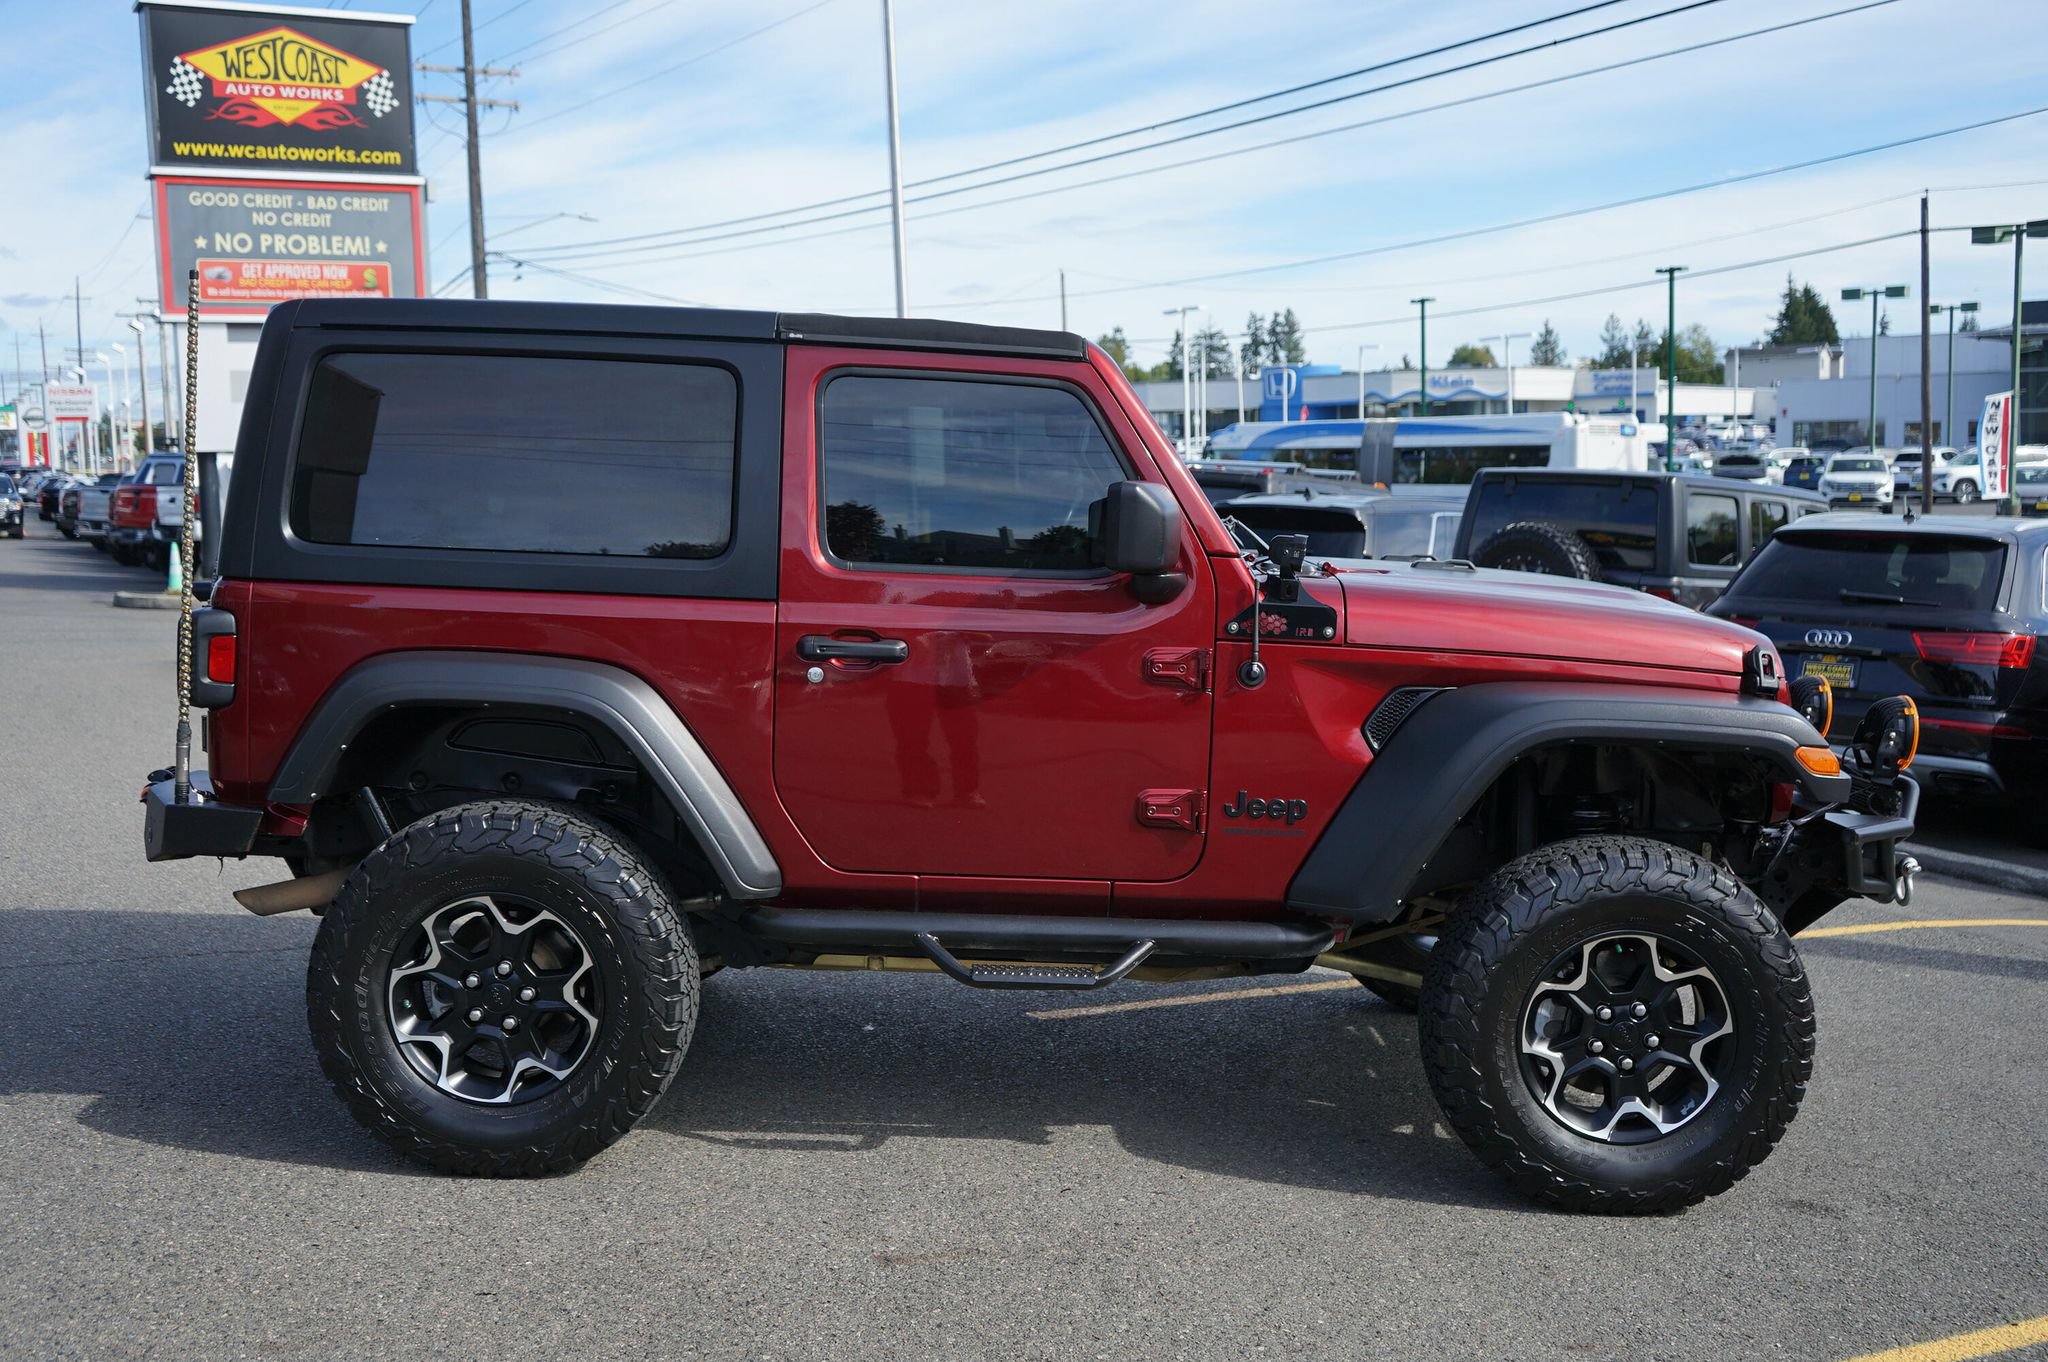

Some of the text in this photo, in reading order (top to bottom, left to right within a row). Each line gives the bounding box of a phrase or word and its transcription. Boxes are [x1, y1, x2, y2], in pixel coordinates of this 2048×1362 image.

[225, 82, 345, 101] AUTO WORKS
[173, 142, 401, 165] www.wcautoworks.com
[188, 191, 240, 208] GOOD
[243, 193, 293, 209] CREDIT
[307, 195, 335, 210] BAD
[341, 197, 389, 212] CREDIT
[252, 212, 332, 228] NO CREDIT
[214, 231, 371, 256] NO PROBLEM!
[242, 263, 348, 280] GET APPROVED NOW
[1223, 790, 1308, 825] Jeep
